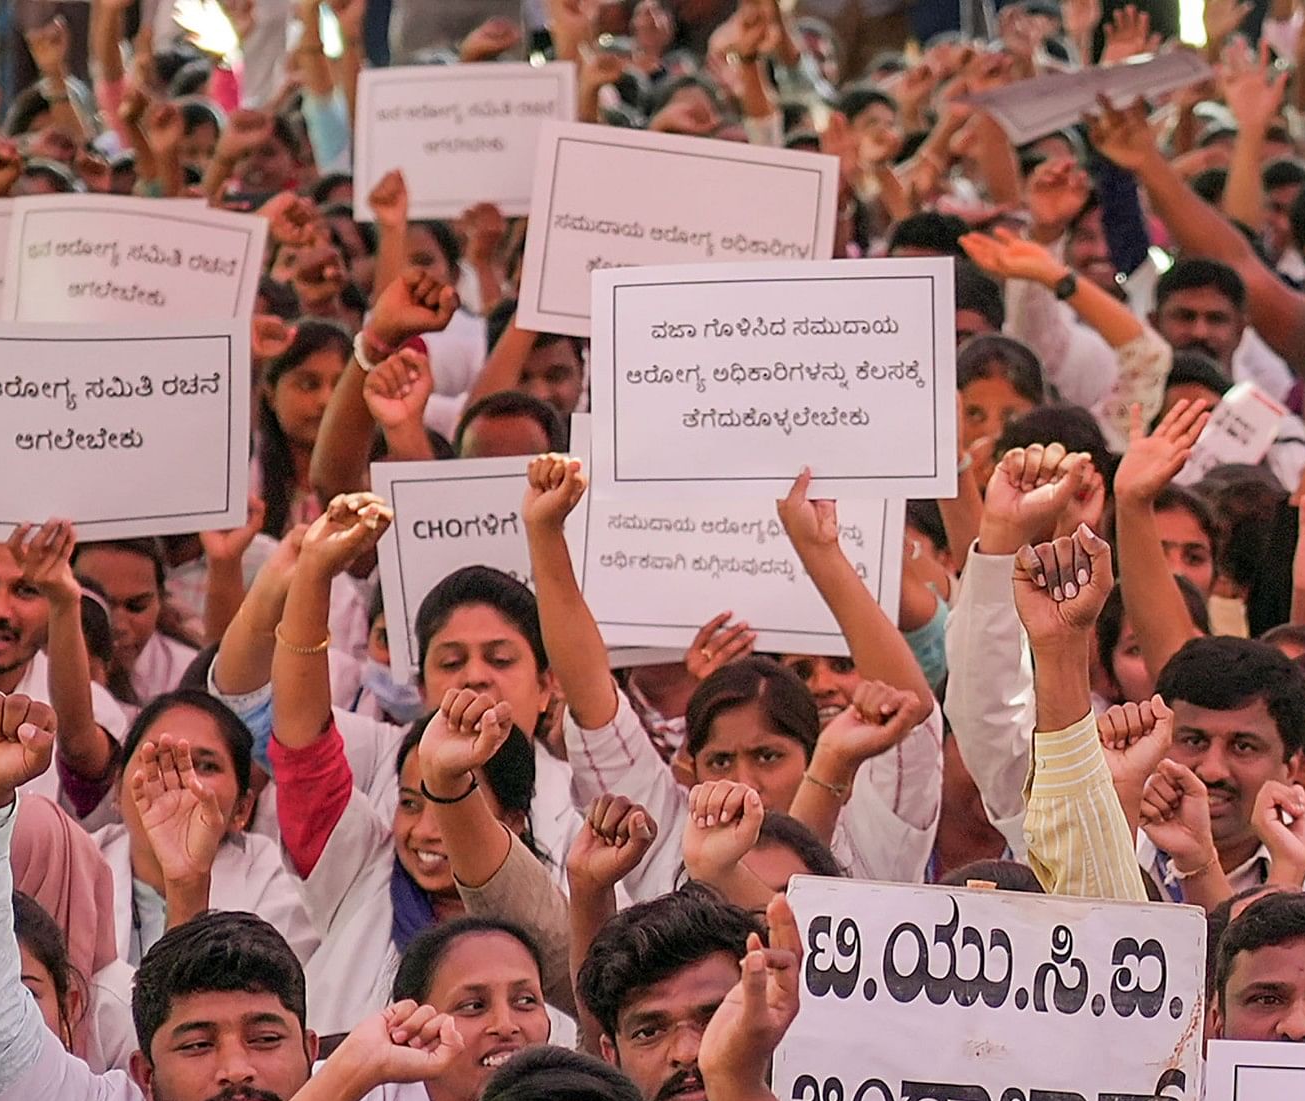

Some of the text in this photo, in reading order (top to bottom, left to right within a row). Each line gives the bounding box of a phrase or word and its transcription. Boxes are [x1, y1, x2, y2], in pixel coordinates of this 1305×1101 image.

[651, 315, 900, 340] ವಜಾ ಗೊಳಿಸಿದ ಸಮುದಾಯ
[85, 375, 154, 399] ಸಮಿತಿ
[161, 371, 221, 396] ರಚನೆ
[626, 359, 926, 394] ಆರೋಗ್ಯ ಅಧಿಕಾರಿಗಳನ್ನು ಕೆಲಸಕ್ಕೆ
[15, 427, 144, 451] ಆಗಲೇಬೇಕು
[412, 511, 518, 540] CHOಗಳಿಗೆ
[607, 513, 697, 533] ಸಮುದಾಯ
